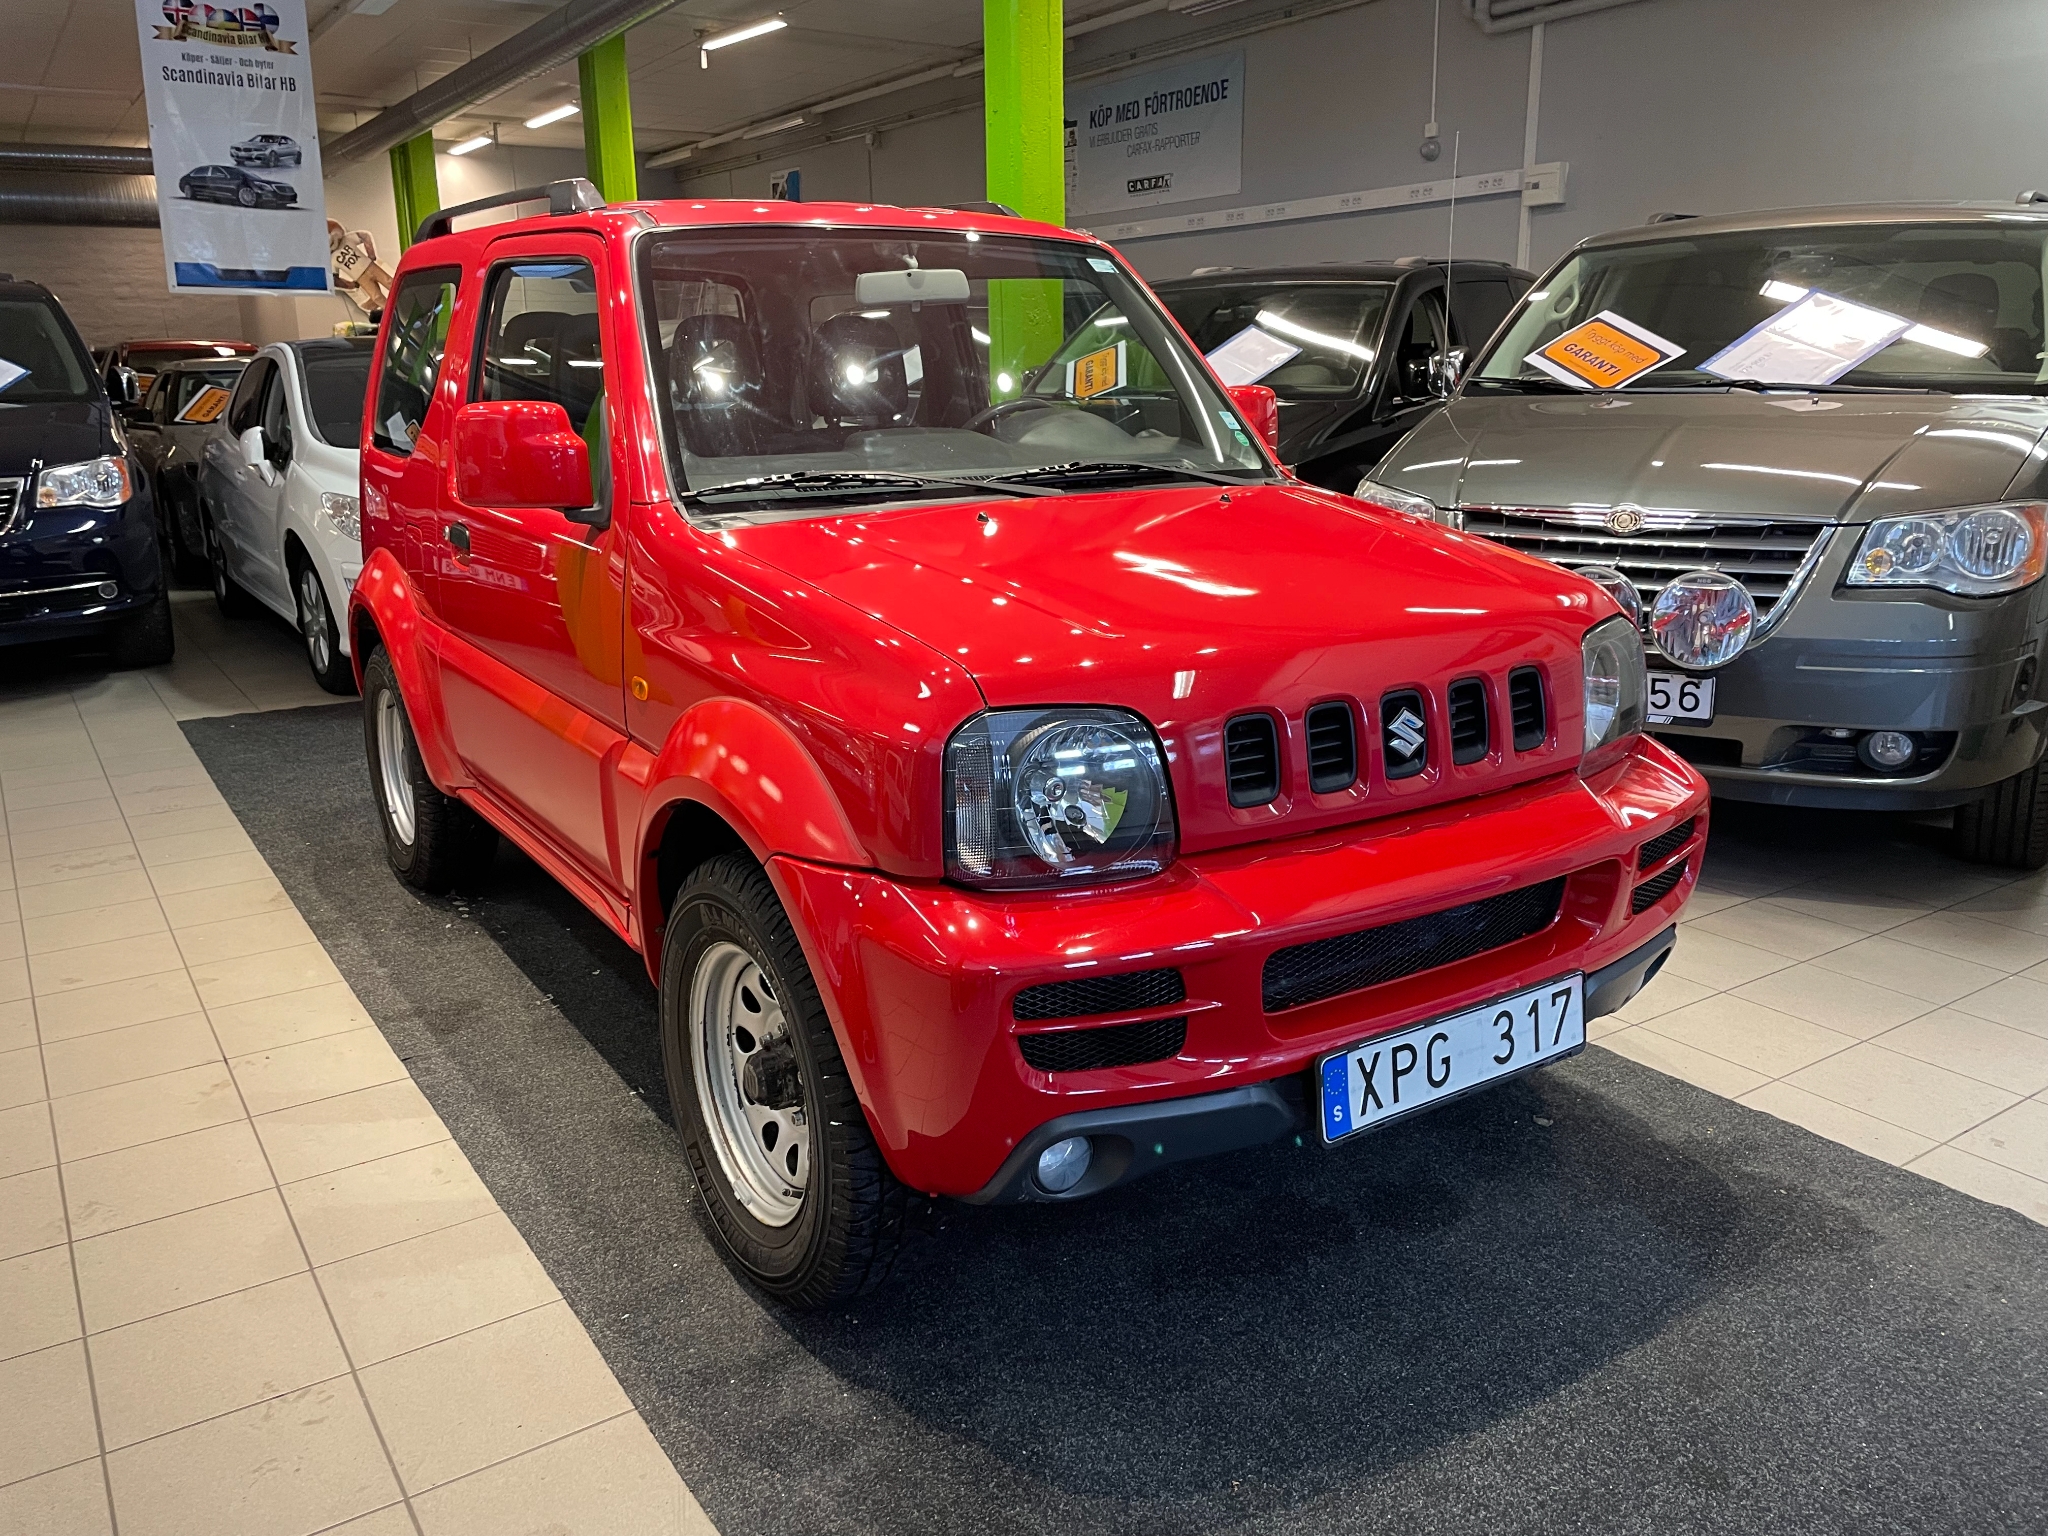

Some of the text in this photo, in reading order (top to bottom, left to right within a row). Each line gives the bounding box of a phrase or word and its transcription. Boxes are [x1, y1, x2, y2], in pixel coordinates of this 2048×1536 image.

[181, 52, 204, 63] Köper
[210, 55, 233, 67] Säljer
[162, 66, 297, 92] Scandinavia Bilar HB
[1088, 78, 1230, 129] KÖP MED FÖRTROENDE
[1096, 128, 1133, 147] ERBJUDER
[1134, 122, 1159, 140] GRATIS
[1126, 131, 1201, 158] CARFAX-RAPPORTER
[1128, 175, 1171, 192] CARFAX
[336, 244, 354, 265] CAR
[344, 251, 361, 270] FOX
[1563, 343, 1622, 377] GARANTI
[1610, 340, 1626, 355] köp
[1624, 349, 1649, 365] med
[1650, 678, 1701, 712] 56
[1357, 986, 1572, 1117] XPG 317
[1333, 1105, 1343, 1122] S
